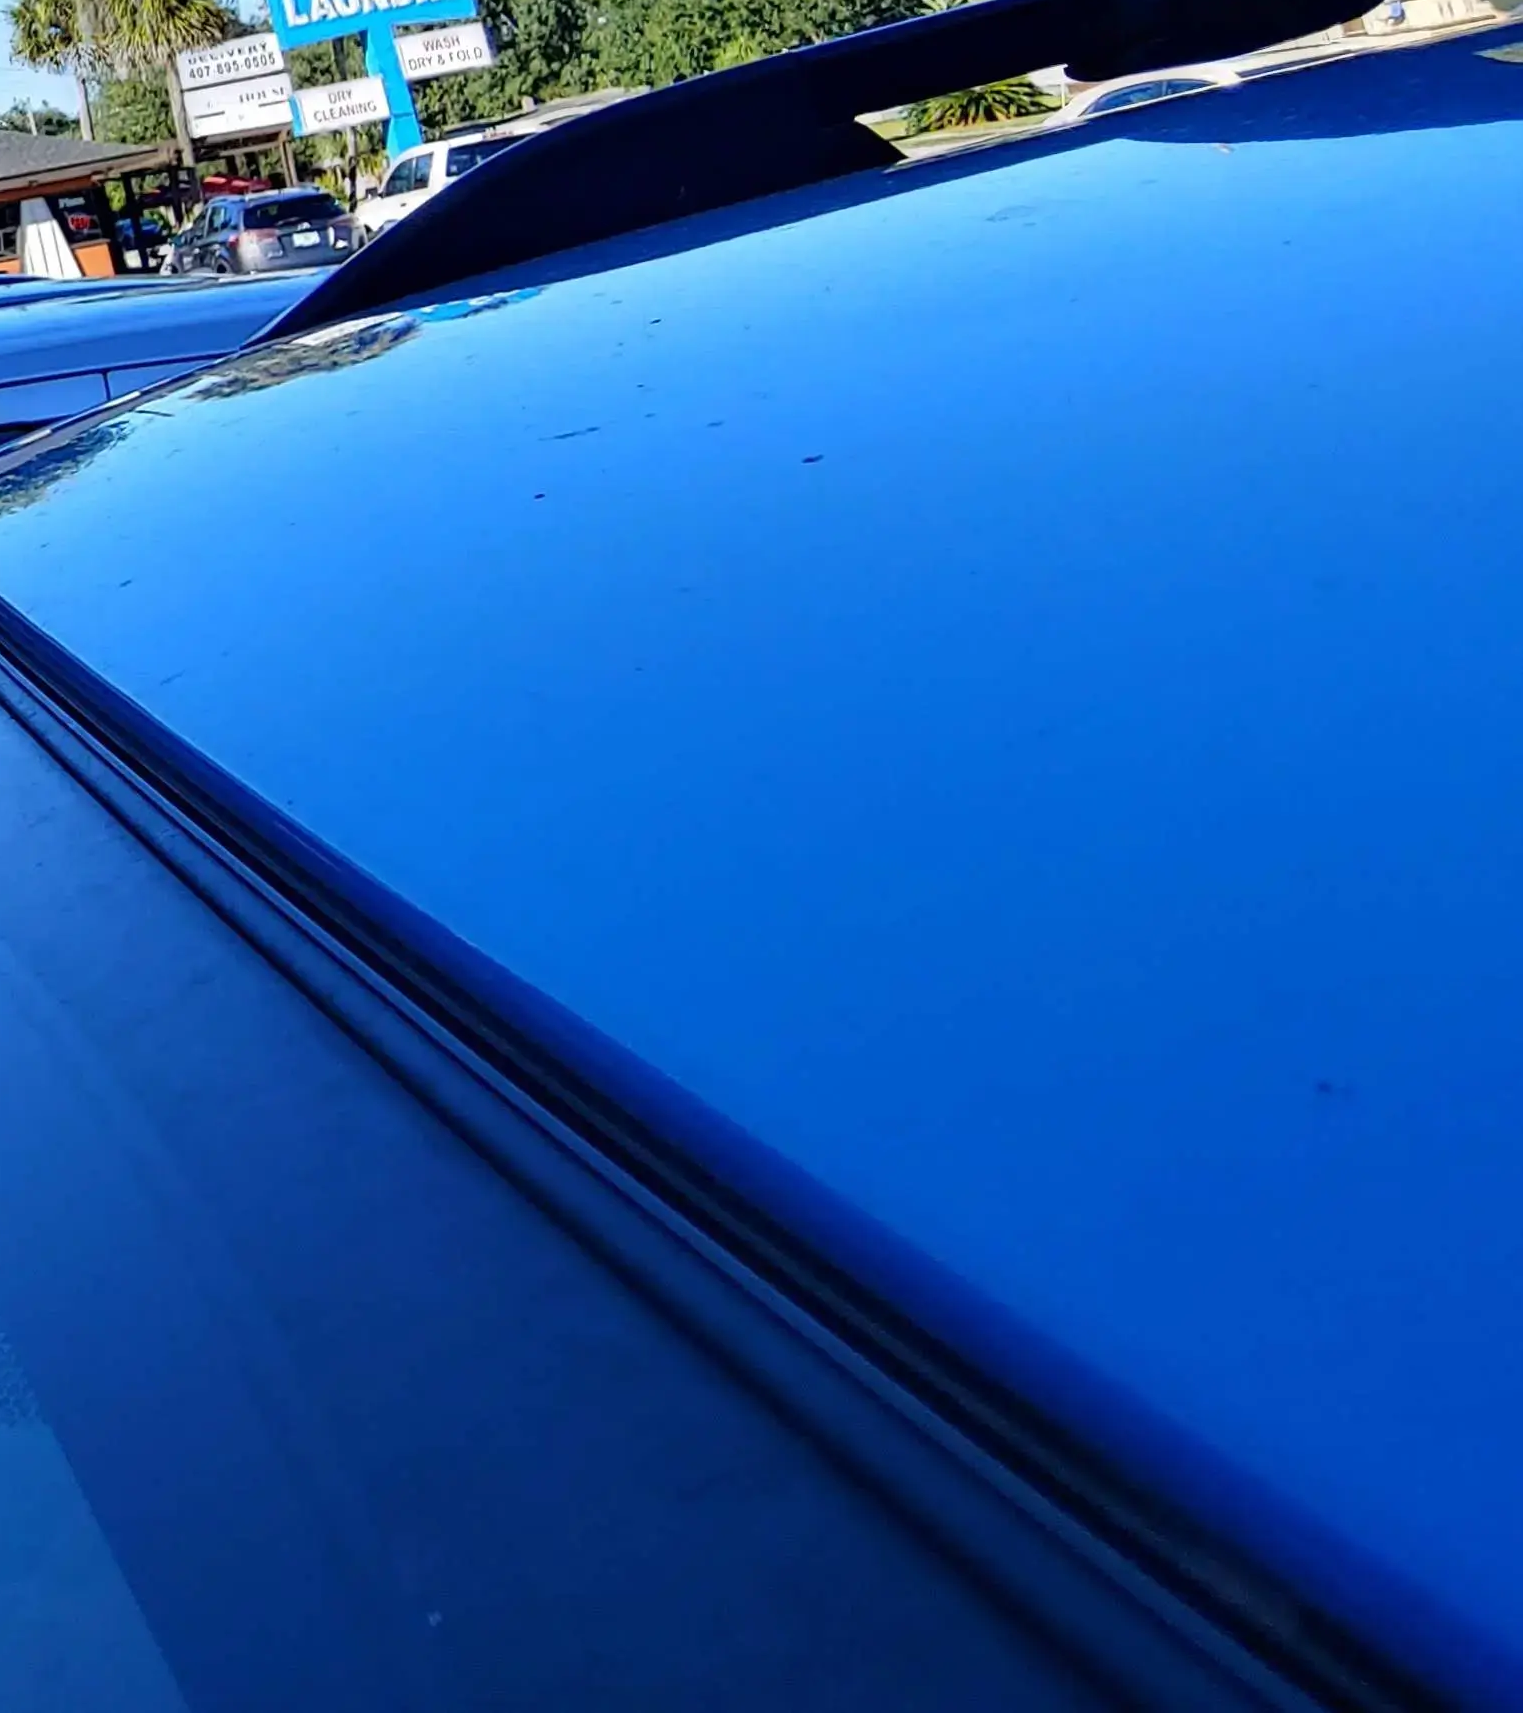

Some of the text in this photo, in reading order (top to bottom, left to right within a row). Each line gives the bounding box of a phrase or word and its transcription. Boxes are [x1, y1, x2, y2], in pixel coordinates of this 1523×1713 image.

[422, 36, 461, 52] WASH
[408, 47, 483, 71] DRY & FOLD
[328, 89, 354, 104] DRY
[313, 101, 378, 123] CLEANING
